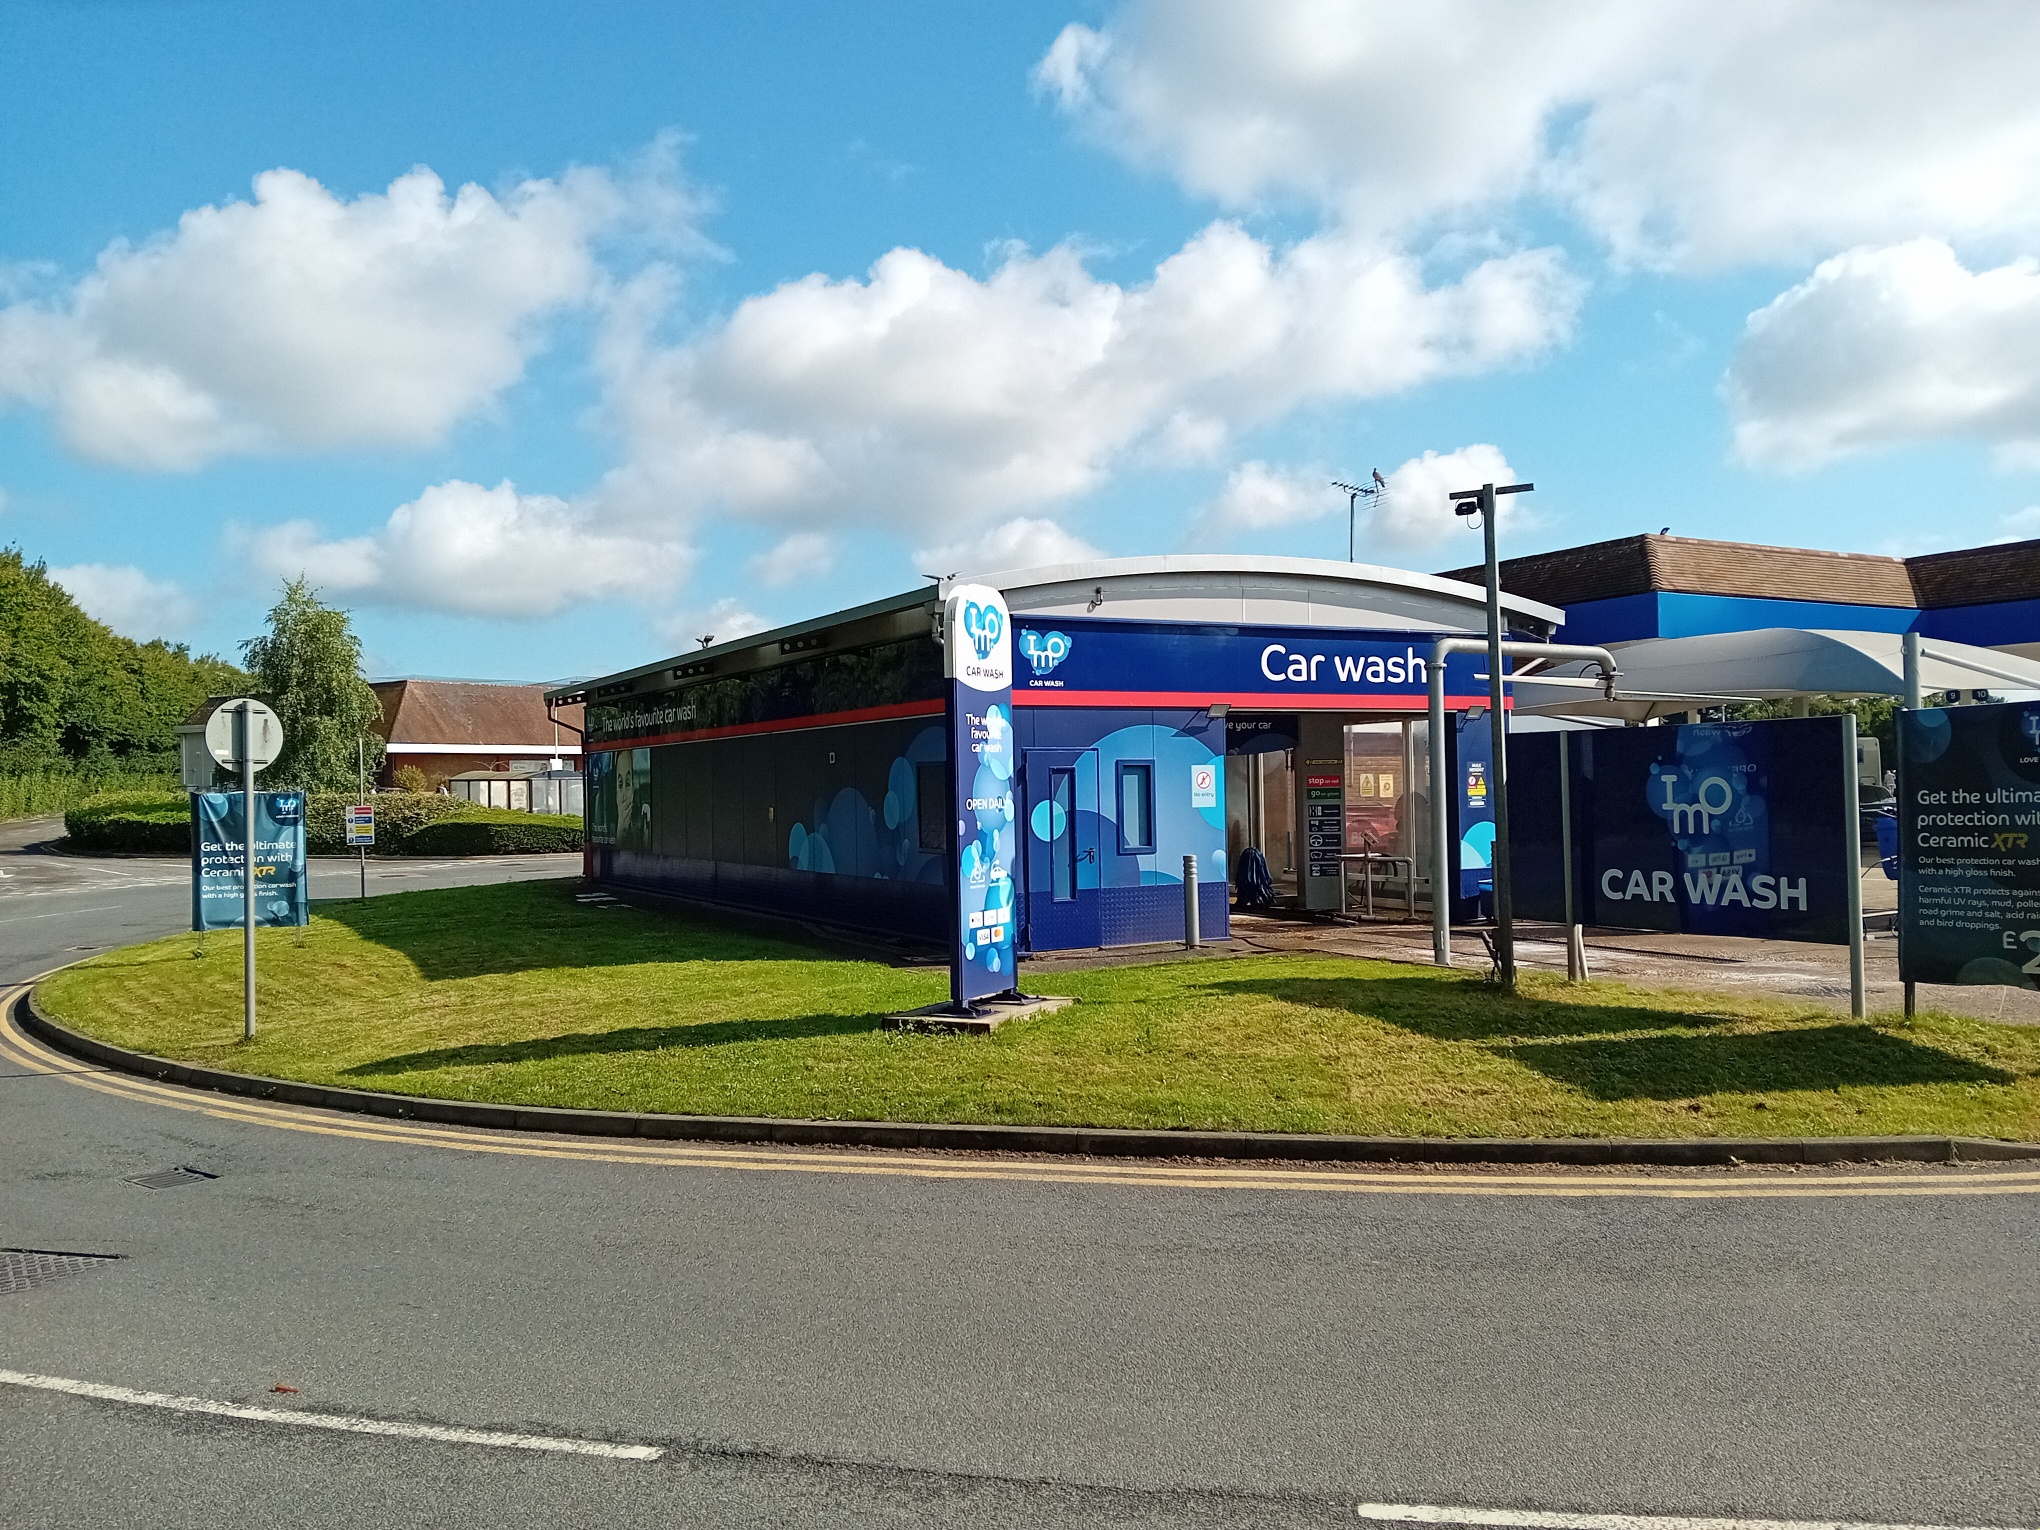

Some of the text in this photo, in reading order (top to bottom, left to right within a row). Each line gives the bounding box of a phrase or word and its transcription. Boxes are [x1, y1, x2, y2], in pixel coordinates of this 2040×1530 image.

[1261, 644, 1428, 683] Car wash
[966, 666, 1004, 679] CAR WASH
[1977, 690, 1986, 698] 10
[603, 716, 613, 732] The
[664, 708, 676, 722] car
[677, 699, 697, 721] wash
[965, 713, 979, 725] The
[1235, 721, 1256, 731] your
[971, 742, 1003, 752] car wash
[1308, 778, 1324, 786] stop
[1917, 790, 1948, 804] Get
[1951, 788, 1980, 804] the
[966, 798, 988, 810] OPEN
[1917, 810, 2010, 829] protection
[201, 840, 297, 851] Get the ltimate
[1917, 832, 2029, 851] Ceramic XTR
[267, 852, 292, 862] with
[1918, 856, 1934, 864] Our
[1936, 856, 1955, 865] best
[1956, 857, 2000, 866] protection
[201, 867, 244, 877] Cerami
[1918, 867, 1937, 875] with
[1945, 868, 1964, 877] high
[1965, 868, 1989, 877] gloss
[1990, 868, 2016, 877] finish.
[1601, 868, 1808, 911] CAR WASH
[1918, 885, 1952, 893] Ceramic
[1953, 886, 1972, 894] XTR
[1973, 887, 2010, 896] protects
[1918, 896, 1952, 905] harmful
[1967, 899, 1989, 908] rays,
[1991, 899, 2014, 908] mud,
[1940, 909, 1965, 917] grime
[1966, 909, 1983, 917] and
[1984, 910, 2003, 919] salt,
[2005, 911, 2025, 919] acid
[1936, 919, 1954, 927] bird
[1955, 920, 2002, 931] droppings.
